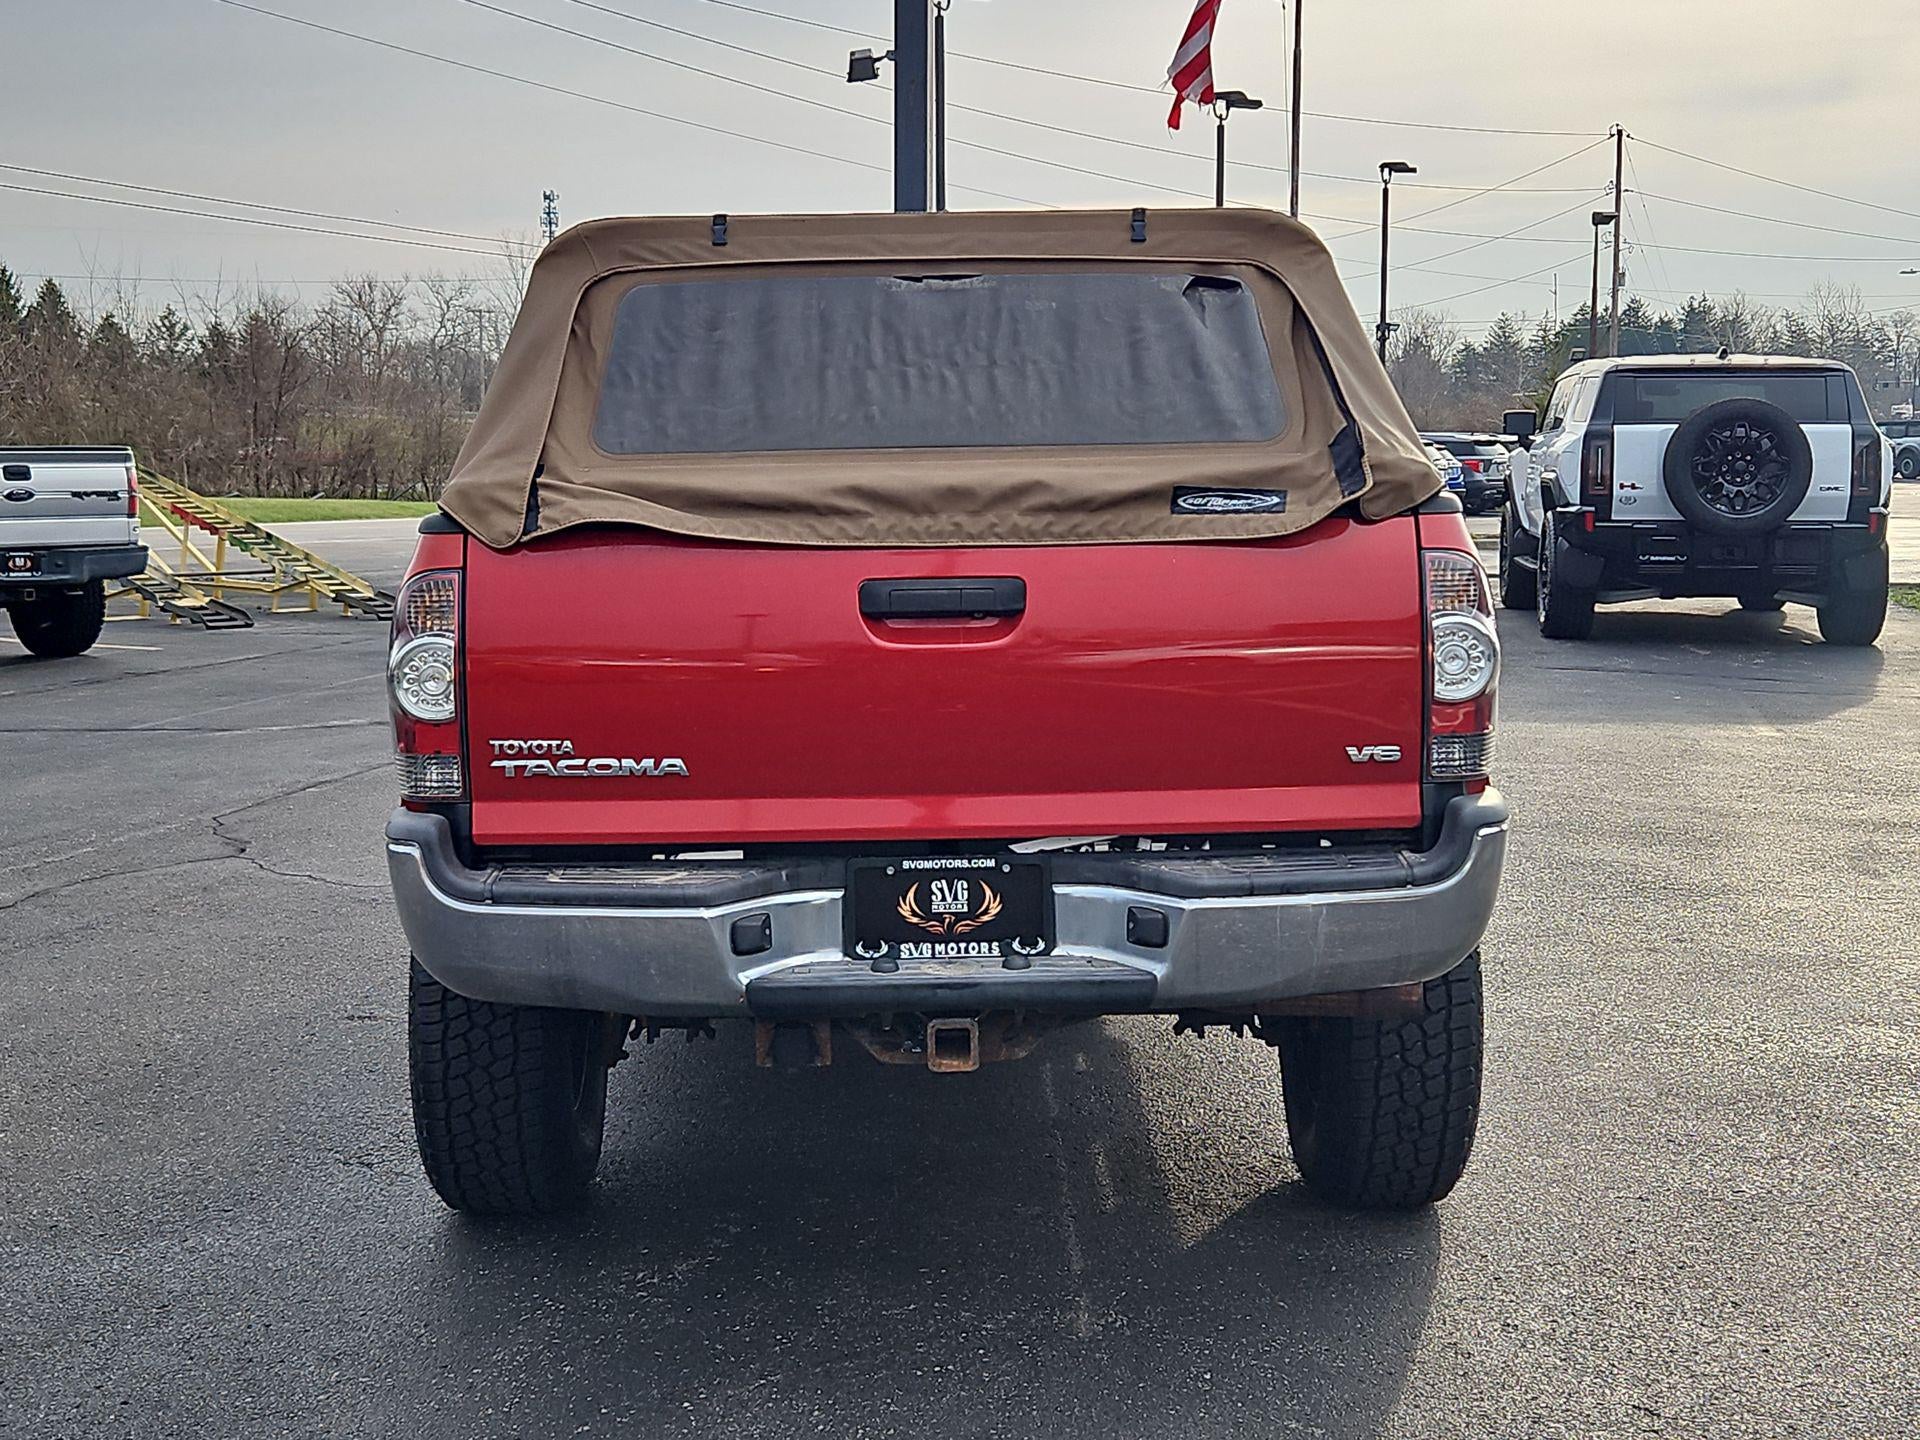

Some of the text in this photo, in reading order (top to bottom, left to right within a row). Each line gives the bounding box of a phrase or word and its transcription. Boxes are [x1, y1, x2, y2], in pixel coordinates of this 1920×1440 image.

[489, 739, 575, 755] TOYOTA
[1344, 745, 1402, 762] V6
[490, 758, 690, 777] TACOMA
[902, 858, 996, 870] SVGMOTORS.COM
[930, 878, 969, 904] SVG
[900, 942, 1000, 957] SVG MOTORS
